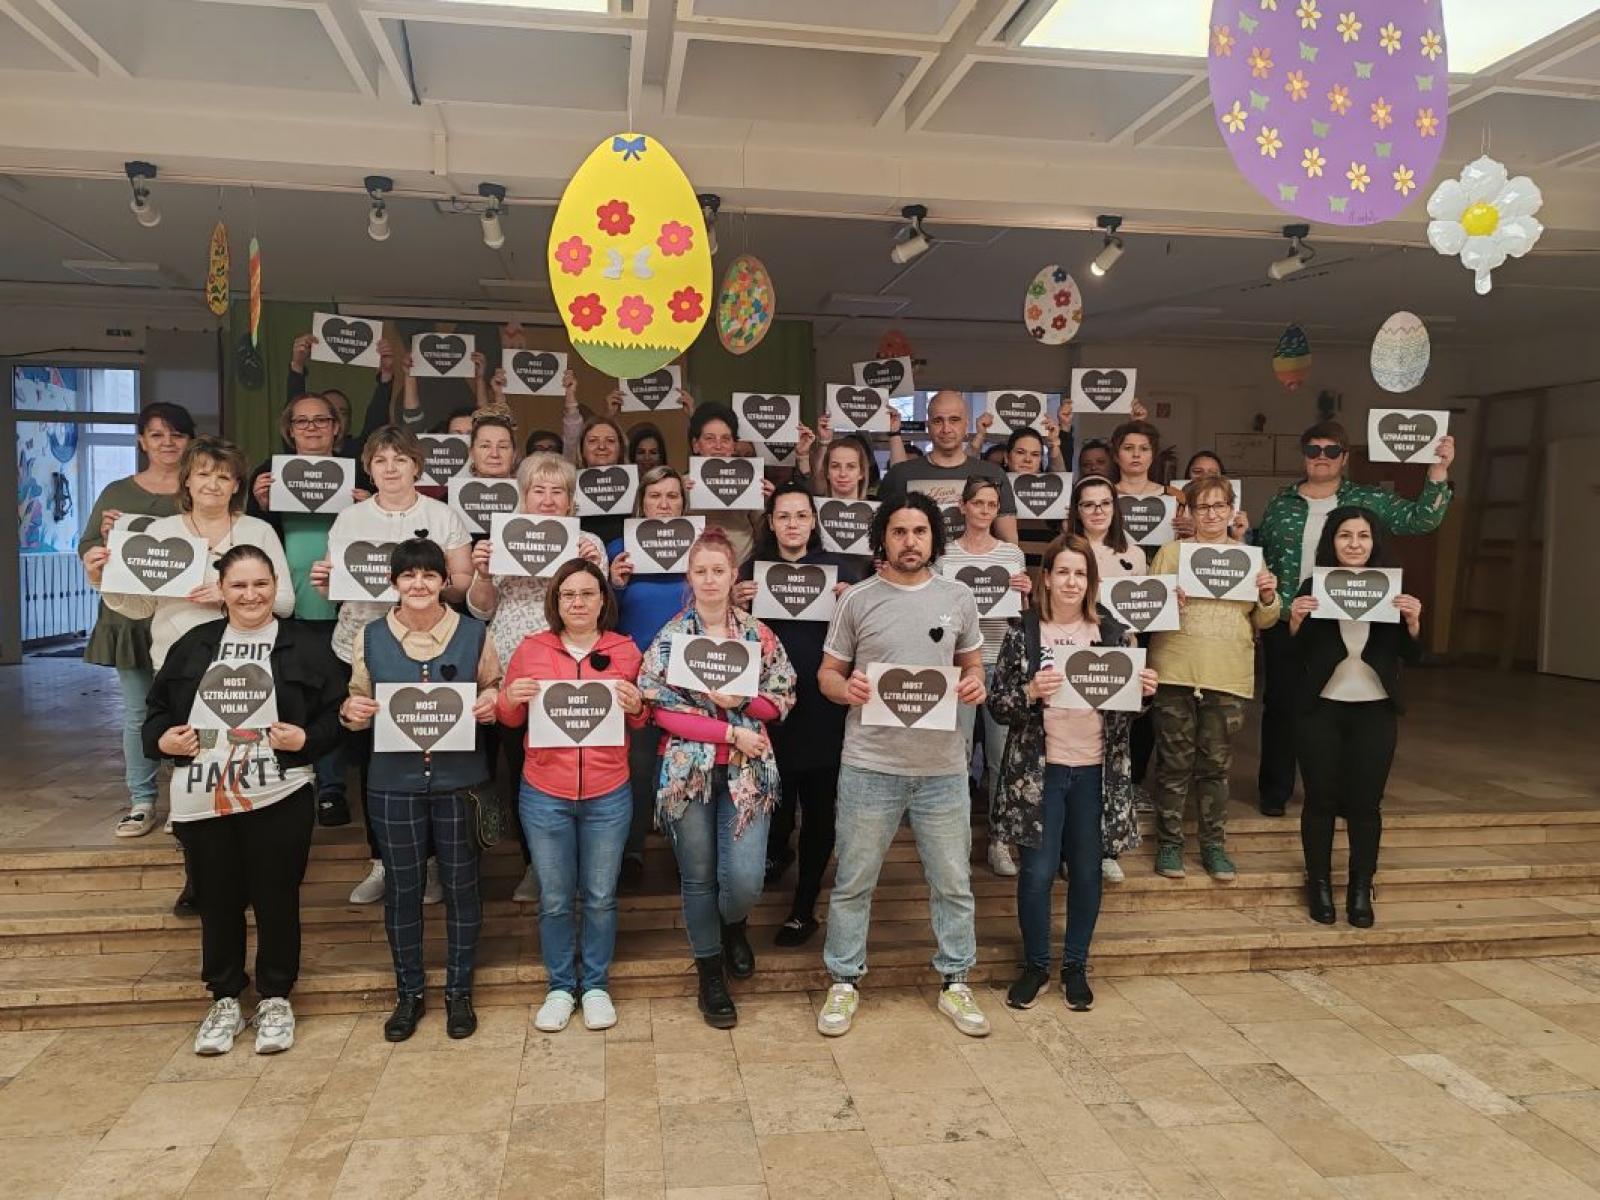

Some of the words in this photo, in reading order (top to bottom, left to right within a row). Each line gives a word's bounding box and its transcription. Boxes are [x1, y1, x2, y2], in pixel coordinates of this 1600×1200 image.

[288, 479, 338, 490] SZTRÁJKOLTAM
[302, 491, 324, 500] VOLNA
[526, 532, 546, 540] MOST
[656, 529, 674, 537] MOST
[508, 541, 562, 552] SZTRÁJKOLTAM
[641, 538, 690, 548] SZTRÁJKOLTAM
[148, 548, 169, 557] MOST
[127, 557, 186, 569] SZTRÁJKOLTAM
[142, 570, 168, 579] VOLNA
[1195, 565, 1244, 577] SZTRÁJKOLTAM
[1208, 579, 1230, 587] VOLNA
[1330, 588, 1383, 598] SZTRÁJKOLTAM
[1344, 600, 1368, 608] VOLNA
[706, 652, 726, 661] MOST
[689, 660, 742, 673] SZTRÁJKOLTAM
[1088, 663, 1109, 671] MOST
[703, 672, 725, 681] VOLNA
[1071, 673, 1126, 684] SZTRÁJKOLTAM
[223, 678, 246, 687] MOST
[902, 682, 924, 690] MOST
[203, 688, 267, 700] SZTRÁJKOLTAM
[883, 690, 939, 701] SZTRÁJKOLTAM
[1085, 687, 1108, 695] VOLNA
[568, 696, 588, 704] MOST
[220, 704, 248, 714] VOLNA
[415, 701, 438, 710] MOST
[897, 704, 921, 713] VOLNA
[550, 705, 606, 717] SZTRÁJKOLTAM
[396, 711, 456, 722] SZTRÁJKOLTAM
[565, 720, 590, 728] VOLNA
[413, 726, 438, 736] VOLNA
